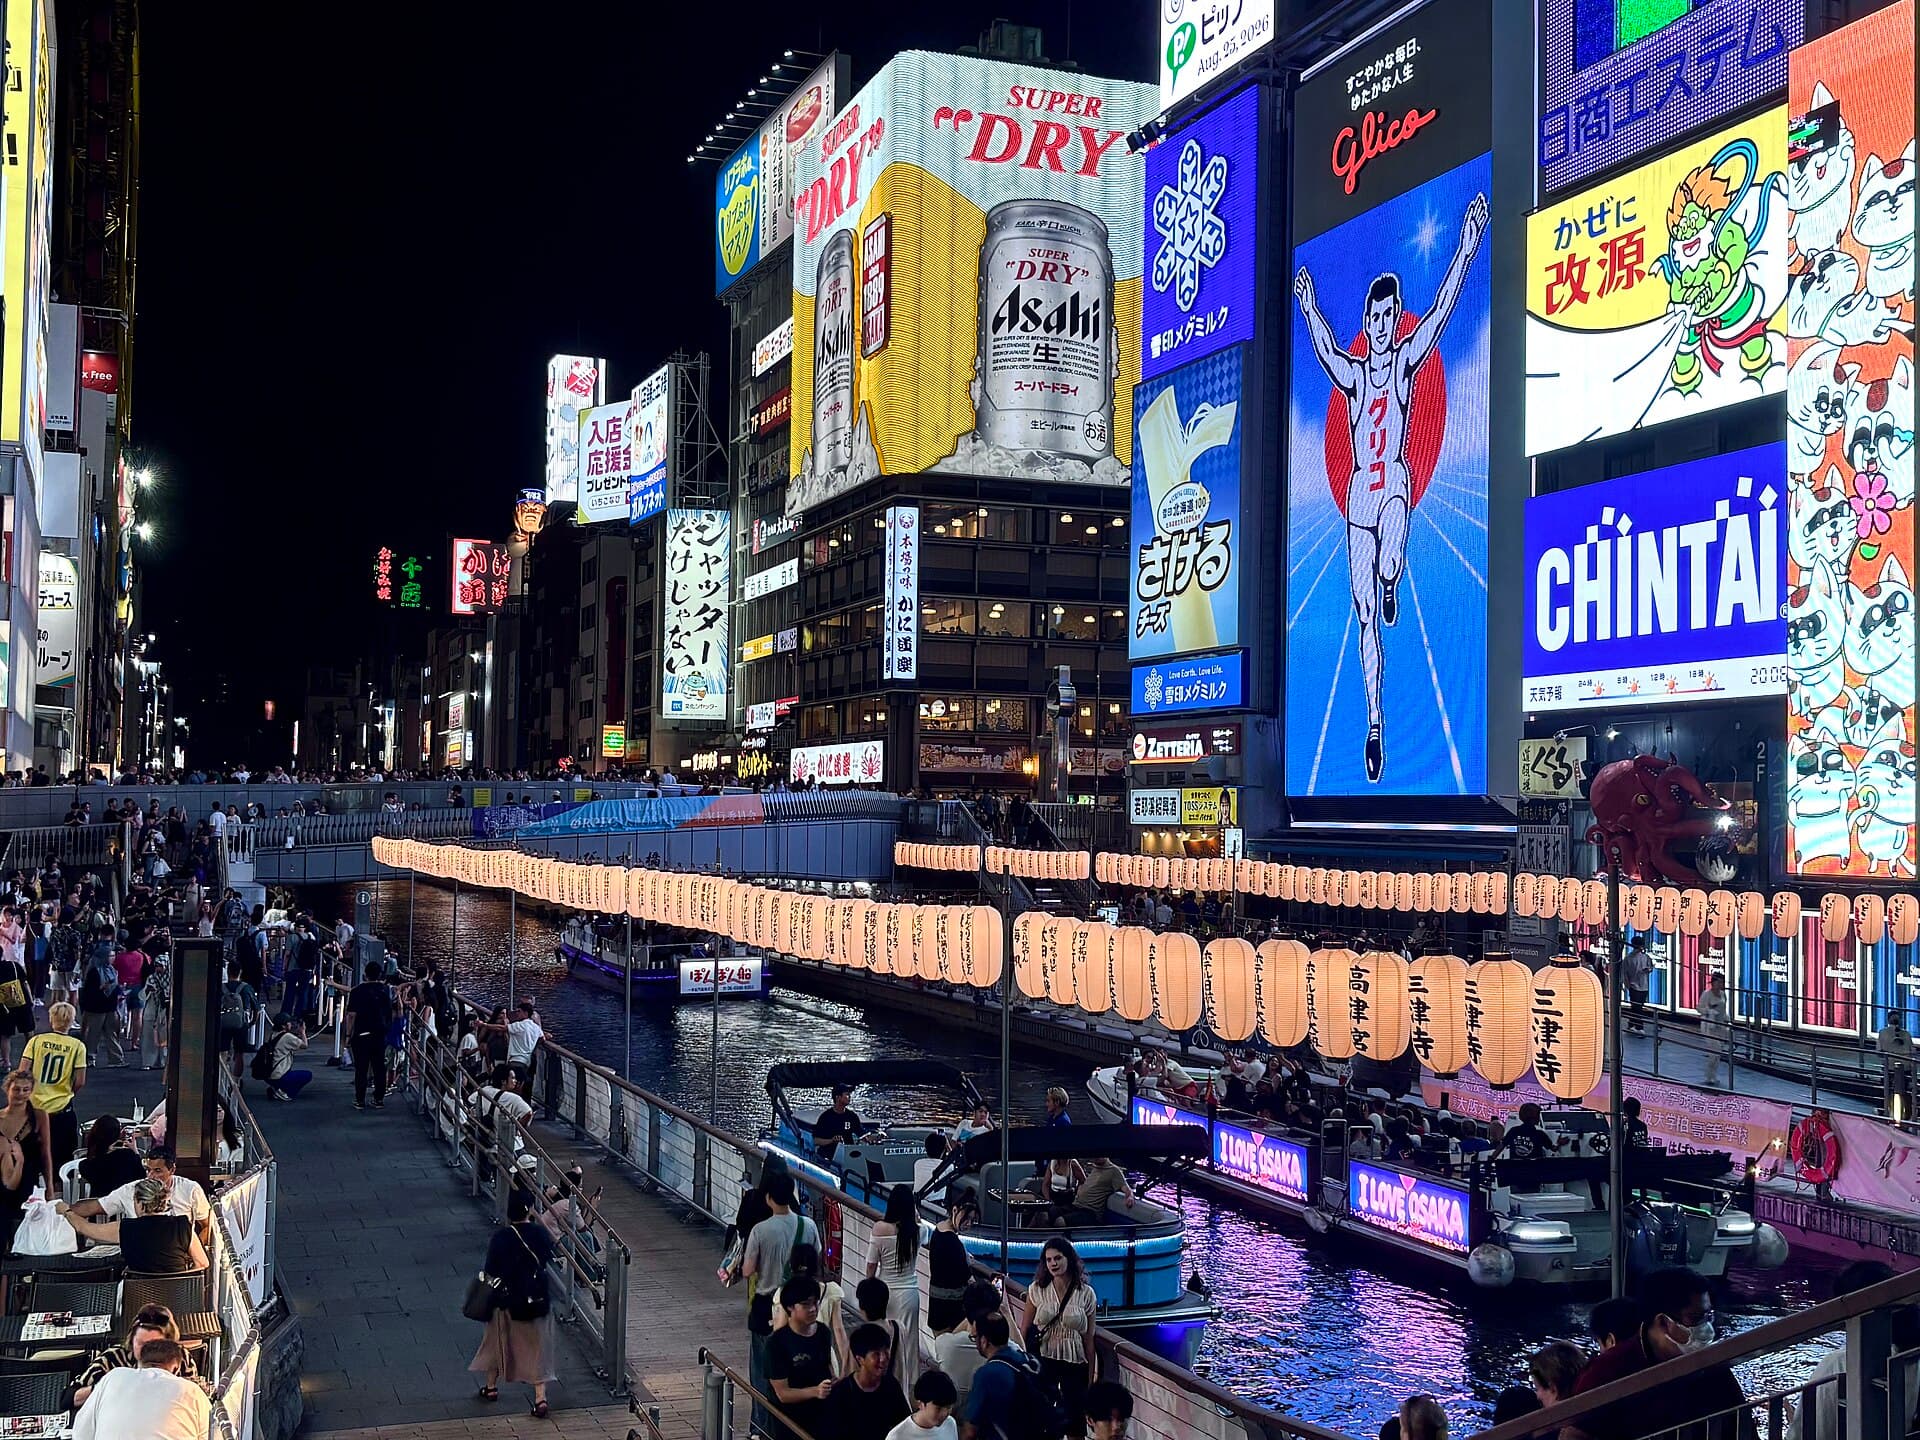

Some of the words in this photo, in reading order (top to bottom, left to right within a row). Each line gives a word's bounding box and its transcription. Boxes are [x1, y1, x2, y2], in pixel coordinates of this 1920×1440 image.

[1198, 51, 1222, 77] Aug.
[1240, 14, 1269, 46] 2026
[1345, 37, 1422, 95] すこやかな毎日、
[1006, 84, 1103, 120] SUPER
[1350, 62, 1415, 111] ゆたかな人生
[1539, 10, 1787, 167] 日商エステム
[820, 103, 861, 164] SUPER
[933, 105, 1125, 178] “DRY
[1331, 108, 1437, 195] Glico
[726, 220, 750, 264] マスク
[863, 224, 885, 270] ASAHI
[1554, 195, 1637, 252] かぜに
[1028, 248, 1069, 261] SUPER
[1545, 226, 1646, 316] 改源
[863, 279, 885, 315] 1889
[991, 284, 1101, 344] Asahi
[816, 309, 851, 375] Asahi
[863, 306, 886, 355] OSAKA
[1033, 343, 1061, 365] 生
[1013, 381, 1079, 397] スーパードライ
[587, 416, 622, 447] 入店
[1030, 420, 1060, 432] 生ビール
[1085, 421, 1107, 443] お酒
[1367, 389, 1390, 493] グリコ
[377, 546, 392, 600] お好み焼
[401, 556, 423, 602] 千房
[693, 513, 727, 665] シャッター
[899, 533, 914, 590] 本場の味
[1137, 519, 1231, 602] さける
[1536, 476, 1779, 652] CHINTAI
[665, 516, 696, 675] だけじゃない
[1136, 601, 1172, 639] チーズ
[896, 595, 914, 673] かに道楽
[1165, 680, 1227, 705] 雪印メグミルク
[1168, 670, 1181, 680] Love
[1181, 668, 1198, 678] Earth.
[1198, 666, 1211, 676] Love
[1211, 664, 1224, 674] Life.
[1529, 685, 1563, 703] 天気予報
[817, 751, 851, 778] かに道楽
[1147, 738, 1204, 758] ZETTERIA
[1531, 746, 1572, 790] くくる
[1348, 964, 1371, 1052] 高津宮
[1408, 975, 1434, 1061] 三津寺
[1464, 979, 1484, 1065] 三津寺
[1531, 988, 1564, 1084] 三津寺
[40, 1051, 65, 1085] 10
[1220, 1131, 1228, 1164] I
[1228, 1135, 1257, 1175] LOVE
[1258, 1146, 1302, 1189] OSAKA
[1358, 1173, 1369, 1210] I
[1369, 1177, 1406, 1221] LOVE
[1408, 1190, 1464, 1240] OSAKA
